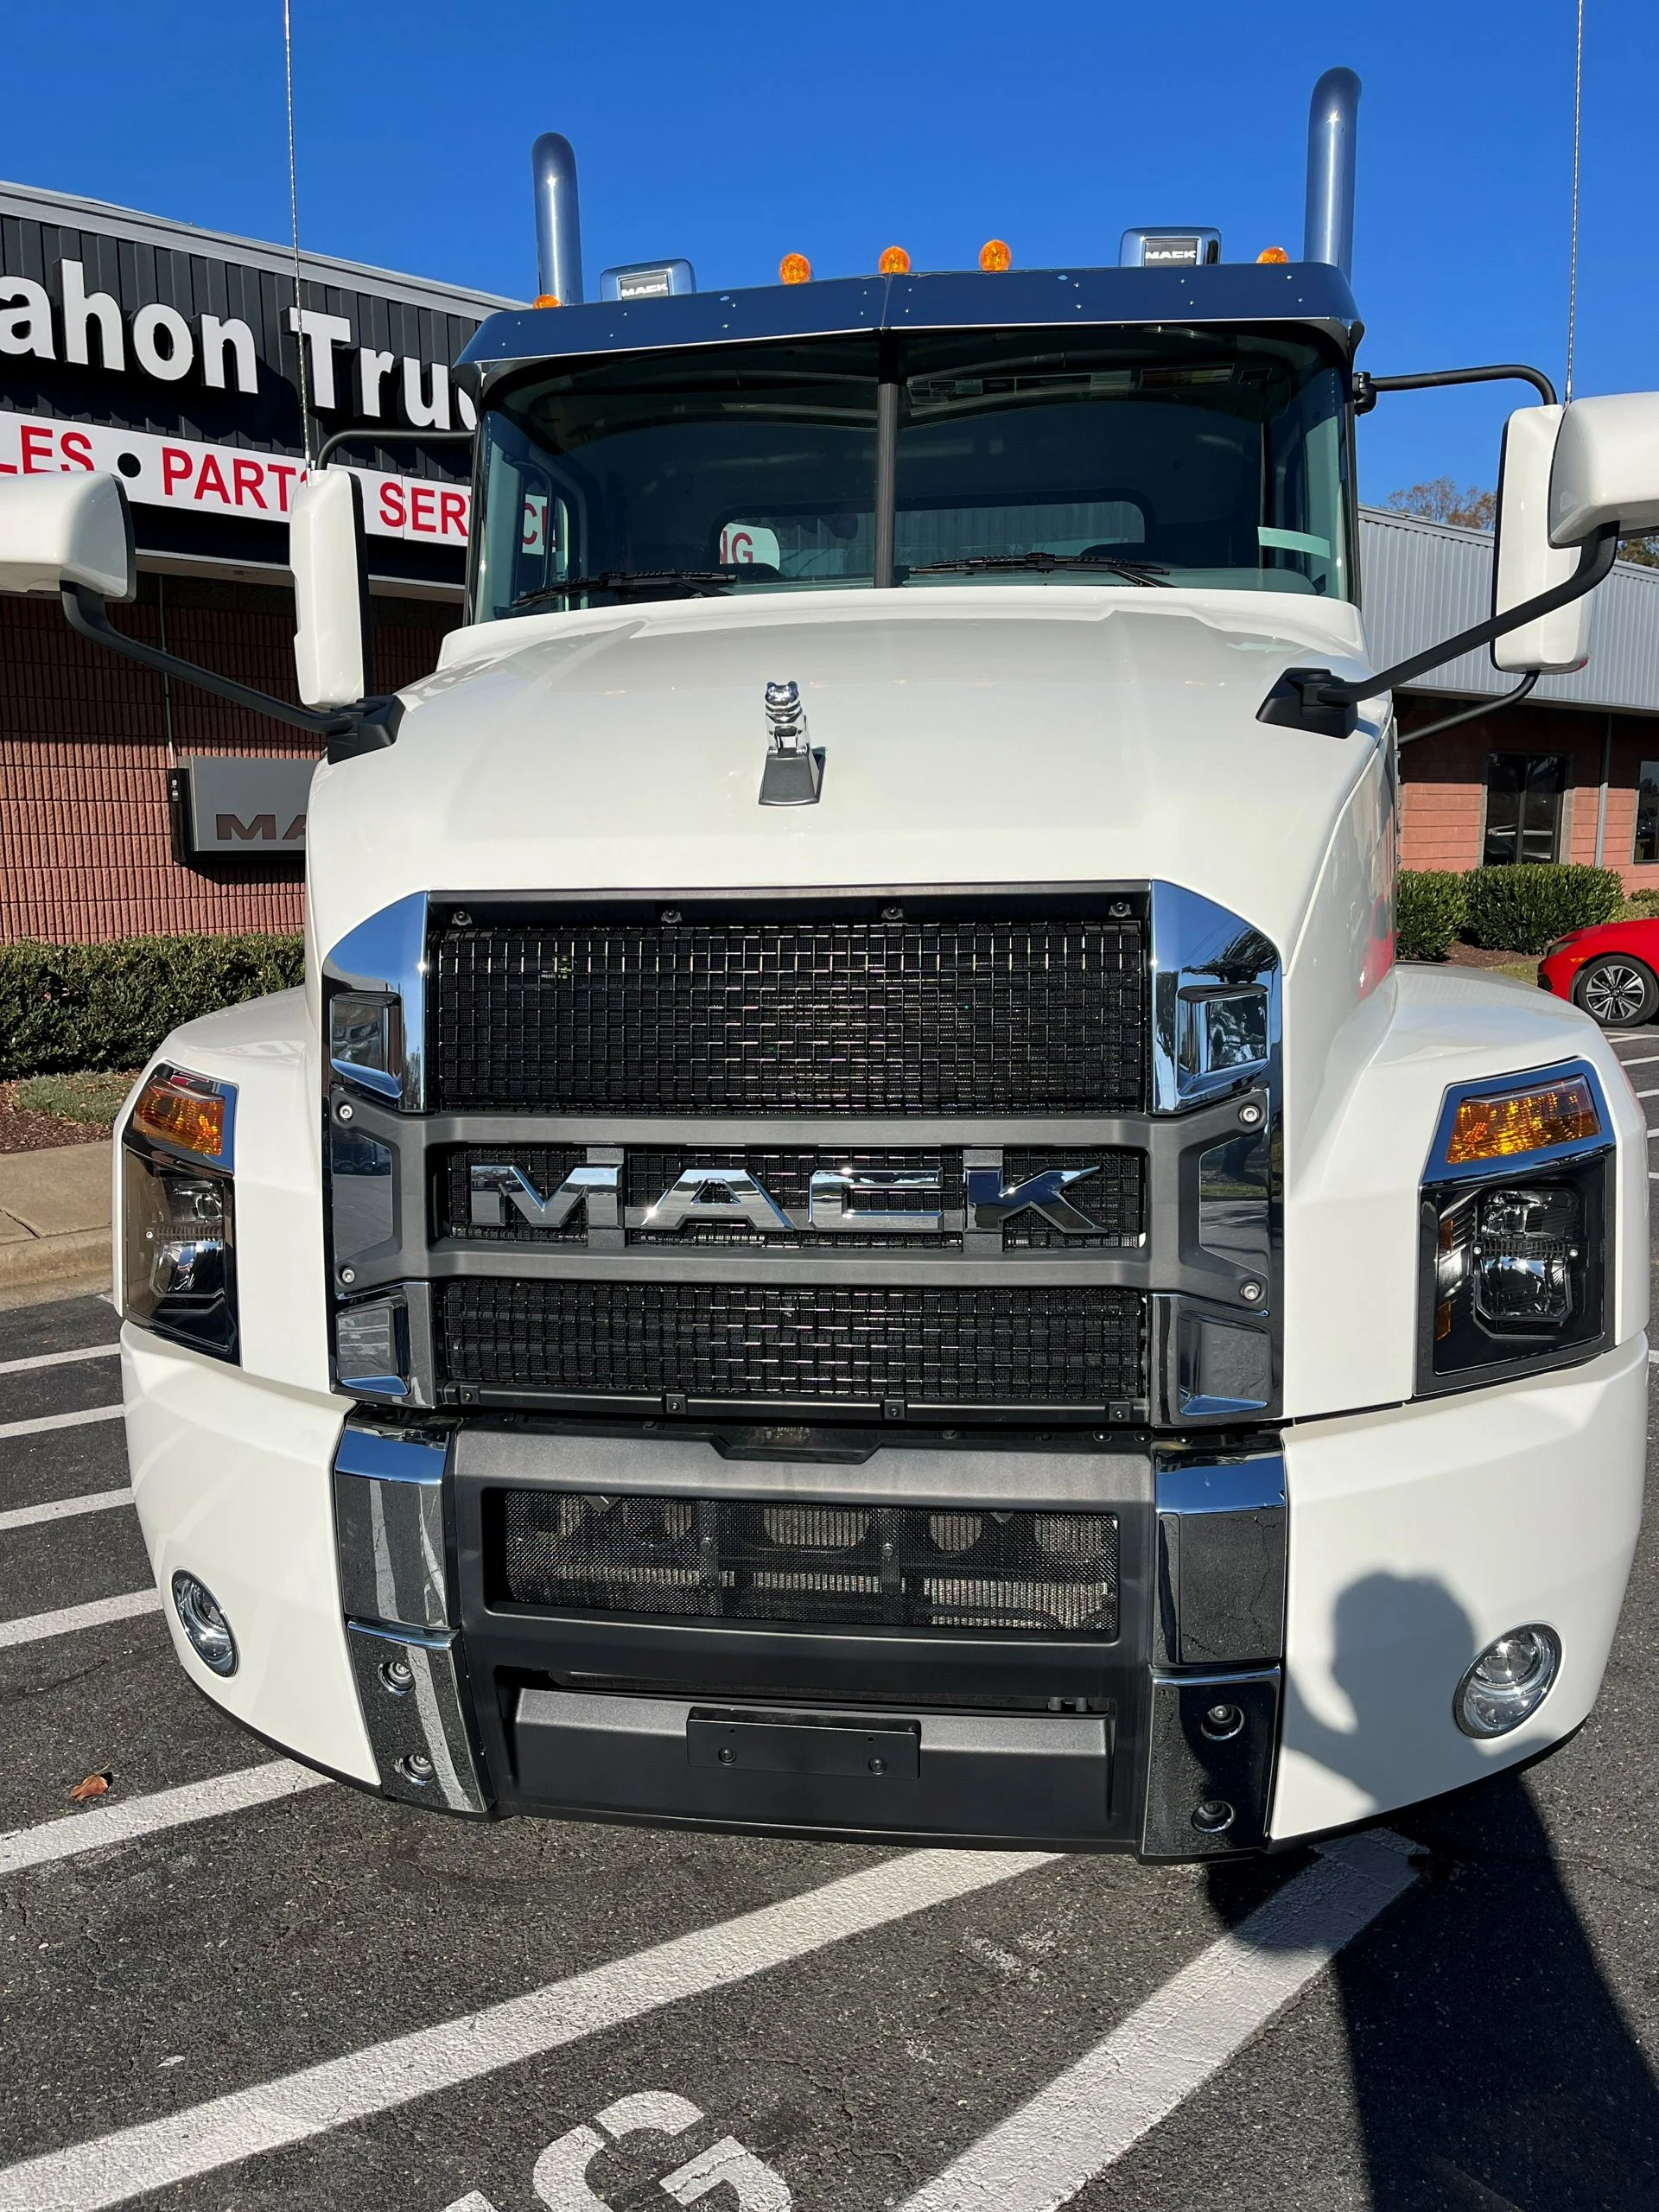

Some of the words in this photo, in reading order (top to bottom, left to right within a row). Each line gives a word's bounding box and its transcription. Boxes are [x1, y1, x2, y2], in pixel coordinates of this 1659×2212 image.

[1145, 250, 1197, 259] MACK
[620, 283, 668, 297] MACK
[0, 258, 258, 394] ahon
[0, 424, 95, 475] ES
[162, 447, 309, 512] PART
[470, 1164, 1109, 1234] MACK
